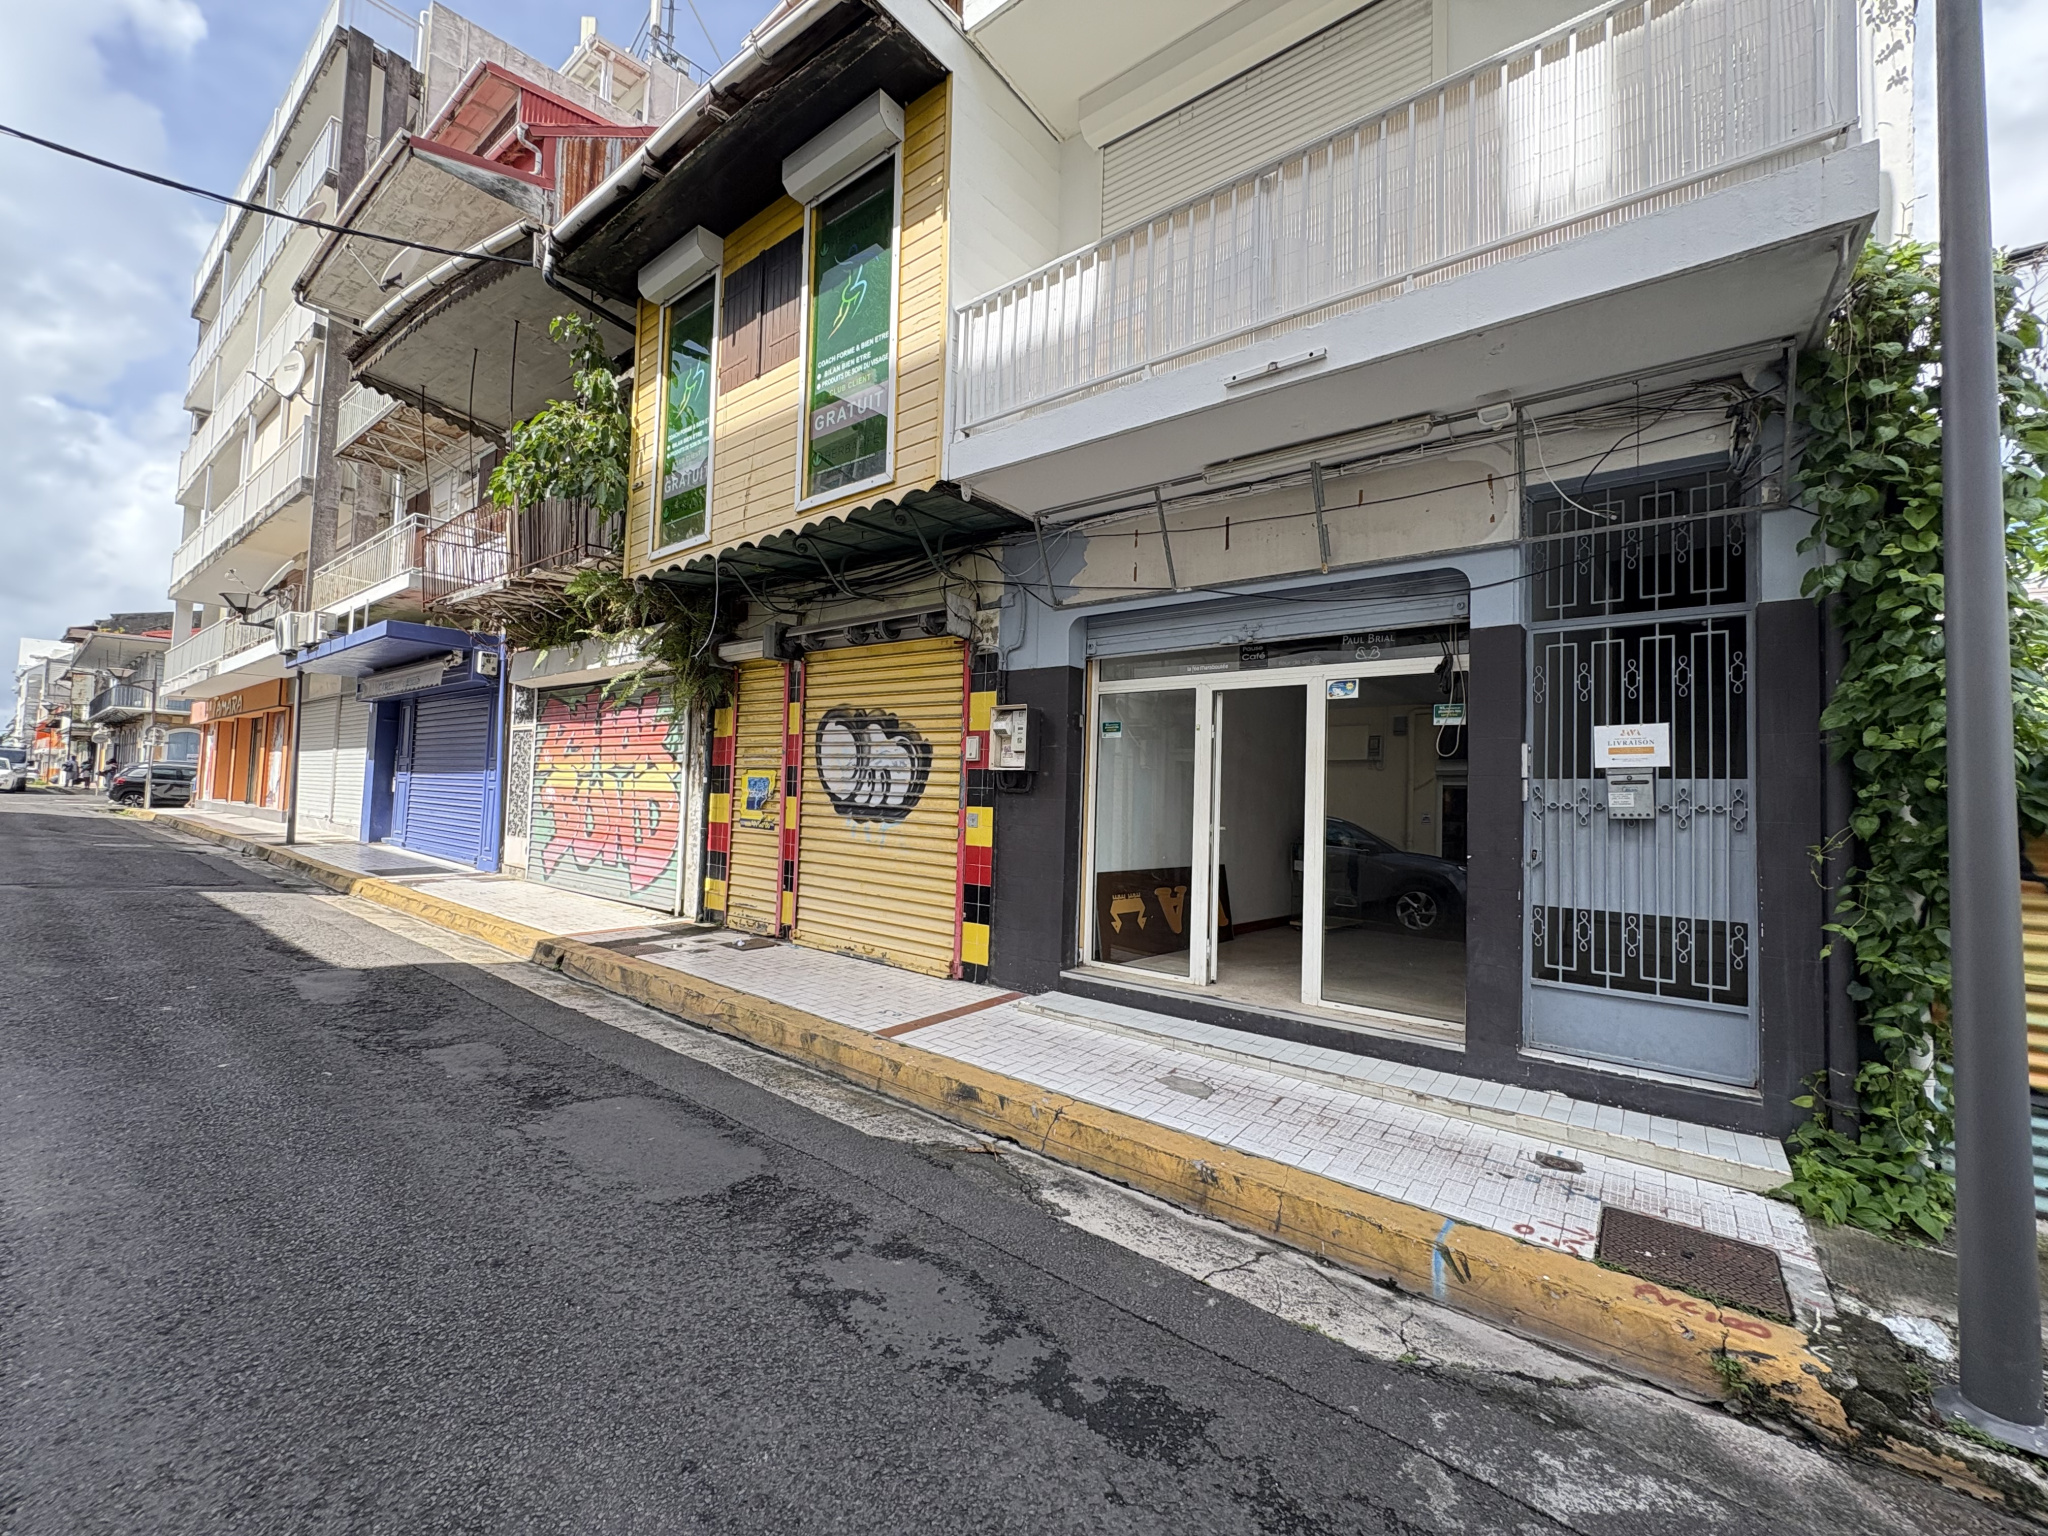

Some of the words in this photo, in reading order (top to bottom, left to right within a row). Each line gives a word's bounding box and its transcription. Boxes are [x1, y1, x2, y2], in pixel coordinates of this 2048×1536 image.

[817, 354, 836, 369] COACH
[837, 346, 855, 361] FORME
[861, 337, 874, 350] BIEN
[875, 330, 889, 344] ETRE
[821, 372, 844, 388] PRODUITS
[844, 370, 852, 379] DE
[851, 364, 863, 375] SOIN
[863, 361, 871, 370] DU
[871, 352, 889, 367] VISAGE
[824, 364, 841, 378] BILAN
[842, 358, 855, 370] BIEN
[856, 351, 871, 364] ETRE
[829, 384, 846, 397] CLUB
[848, 373, 871, 389] CLIENT
[815, 390, 885, 431] GRATUIT
[1342, 635, 1365, 645] PAUL
[1367, 633, 1395, 644] BRIAL
[1241, 652, 1266, 661] Café
[213, 694, 243, 719] TAMARA
